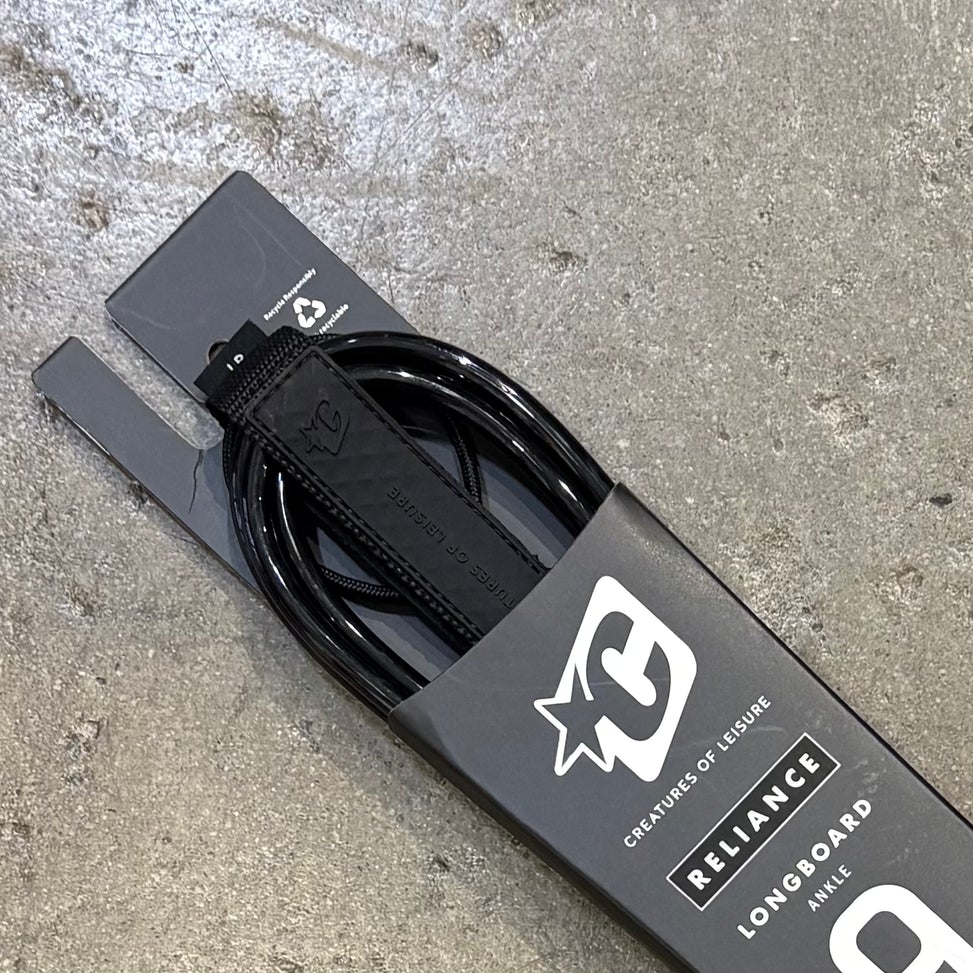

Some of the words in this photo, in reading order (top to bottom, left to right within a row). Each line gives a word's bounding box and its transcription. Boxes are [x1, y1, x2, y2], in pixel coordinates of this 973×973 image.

[263, 298, 285, 321] Recycle
[282, 268, 317, 301] Responsibly
[387, 487, 447, 543] LEISURE
[446, 546, 469, 564] OF
[623, 772, 698, 848] CREATURES
[696, 749, 717, 772] OF
[716, 695, 772, 752] LEISURE
[686, 752, 821, 891] RELIANCE
[737, 799, 872, 940] LONGBOARD
[807, 864, 852, 912] ANKLE
